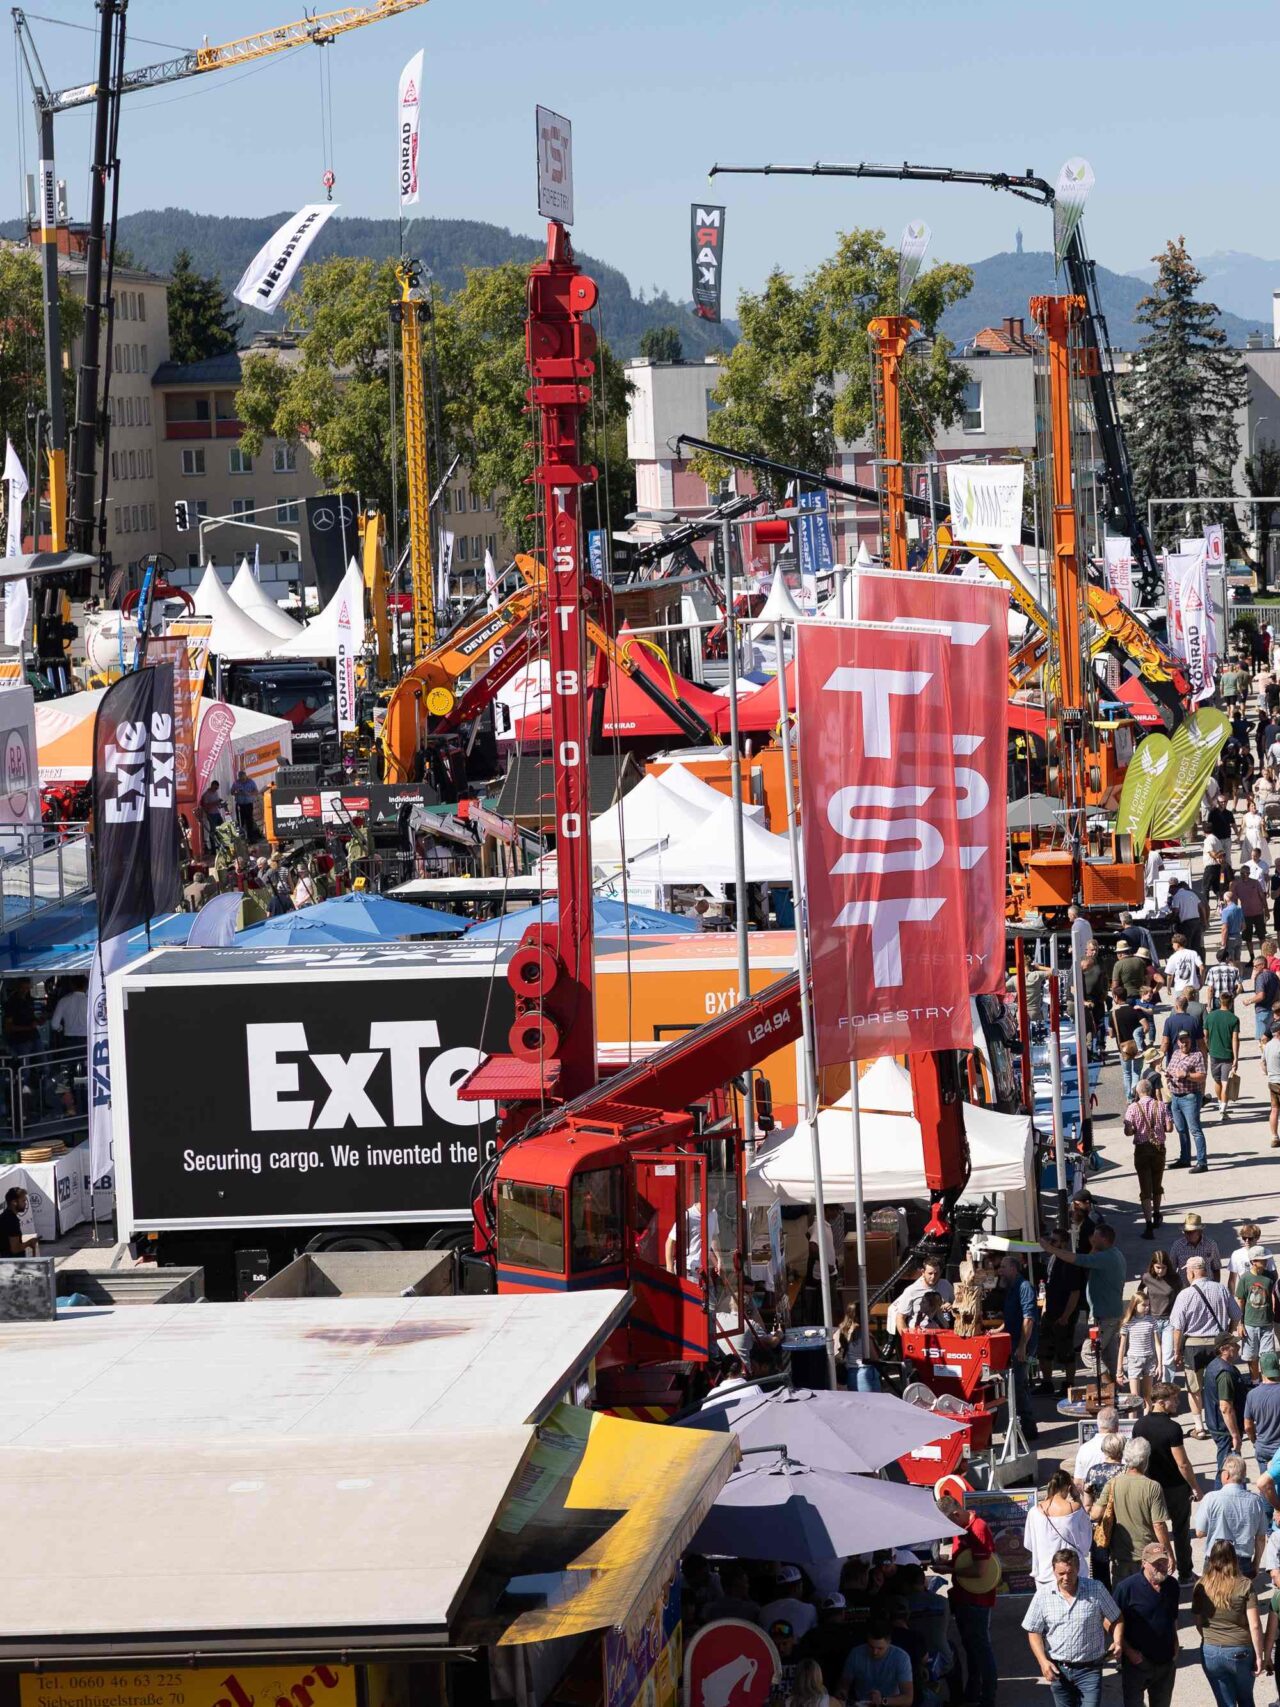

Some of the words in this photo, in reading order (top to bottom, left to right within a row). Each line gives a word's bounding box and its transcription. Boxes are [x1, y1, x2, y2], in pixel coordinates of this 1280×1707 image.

[401, 122, 412, 196] KONRAD
[541, 125, 569, 185] TST
[46, 170, 55, 225] LIEBHERR
[257, 211, 320, 299] LIEBHERR
[1109, 564, 1118, 585] PENZ
[1120, 558, 1129, 586] CRANE
[1188, 625, 1205, 695] KONRAD
[339, 643, 348, 721] KONRAD
[604, 722, 636, 730] KONRAD
[388, 794, 425, 804] Individuelle
[1128, 782, 1143, 813] FORST
[822, 666, 946, 989] TST
[748, 1008, 791, 1045] L24.94
[838, 1005, 956, 1030] FORESTRY
[183, 1148, 263, 1174] Securing
[269, 1149, 325, 1171] cargo.
[330, 1145, 360, 1168] We
[366, 1141, 443, 1167] invented
[448, 1141, 478, 1165] the
[921, 1348, 946, 1358] TST
[37, 1676, 62, 1690] Tel.
[69, 1676, 105, 1689] 0660
[110, 1675, 128, 1688] 46
[133, 1675, 151, 1687] 63
[157, 1674, 183, 1687] 225
[37, 1692, 164, 1707] Siebenhügelstraße
[169, 1692, 185, 1705] 70
